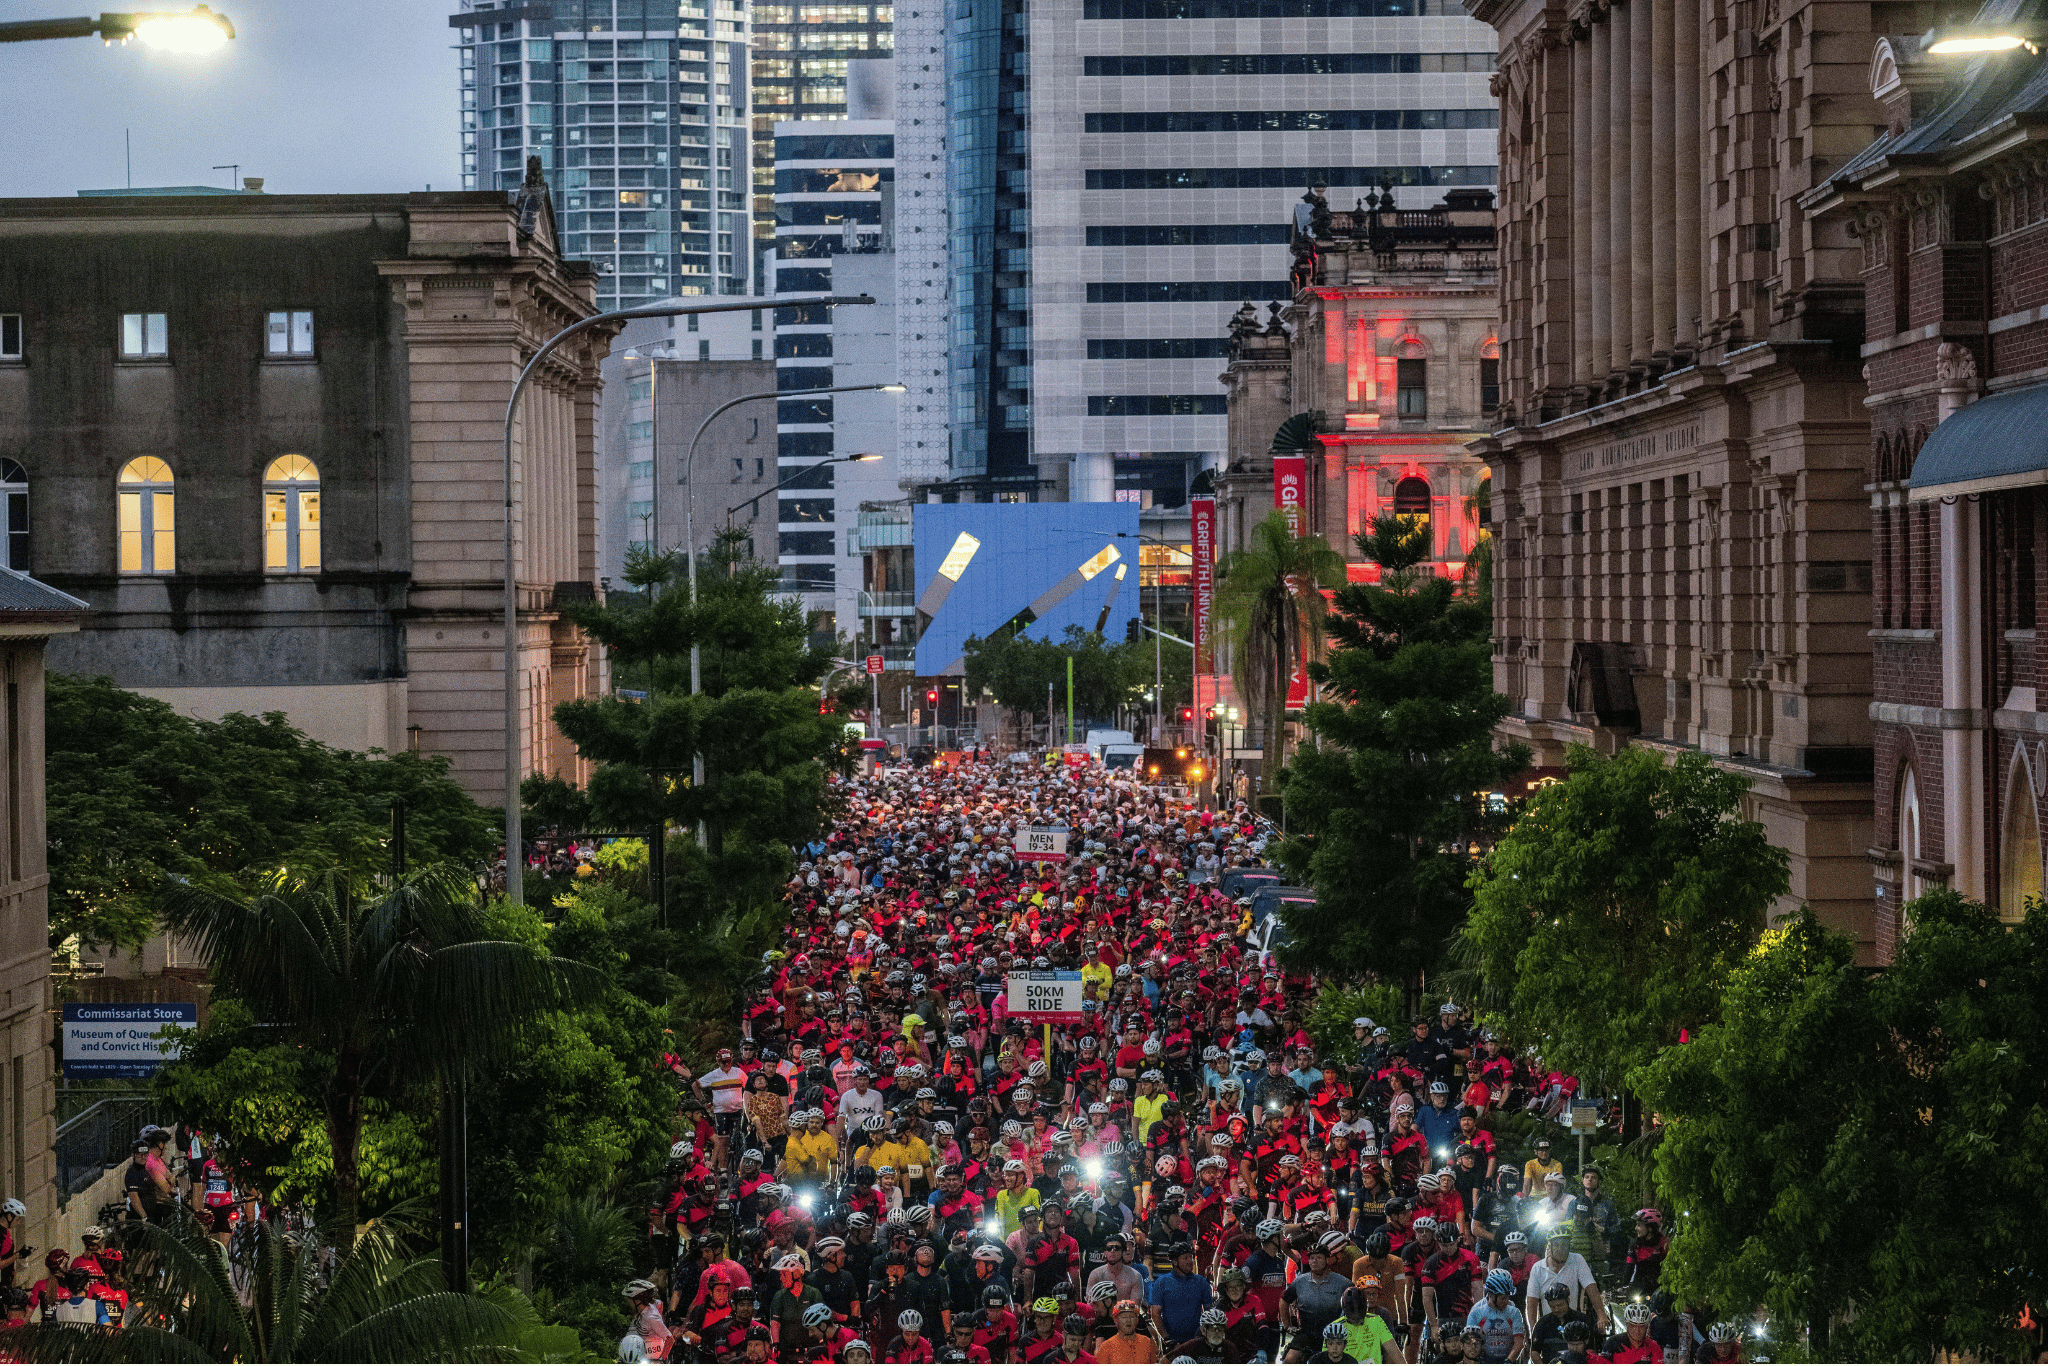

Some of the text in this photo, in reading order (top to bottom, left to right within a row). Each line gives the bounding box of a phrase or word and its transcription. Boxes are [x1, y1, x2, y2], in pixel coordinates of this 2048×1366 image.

[1665, 425, 1699, 452] BUILDING
[1197, 520, 1210, 584] GRIFFITH
[1030, 834, 1054, 843] MEN
[1028, 842, 1054, 851] 19-34
[1011, 972, 1028, 980] UCI
[1026, 985, 1064, 997] 50KM
[1028, 998, 1062, 1011] RIDE
[77, 1008, 183, 1019] Commissariat Store
[71, 1029, 113, 1039] Museum
[115, 1029, 127, 1039] of
[81, 1041, 99, 1051] and
[102, 1041, 140, 1051] Convict
